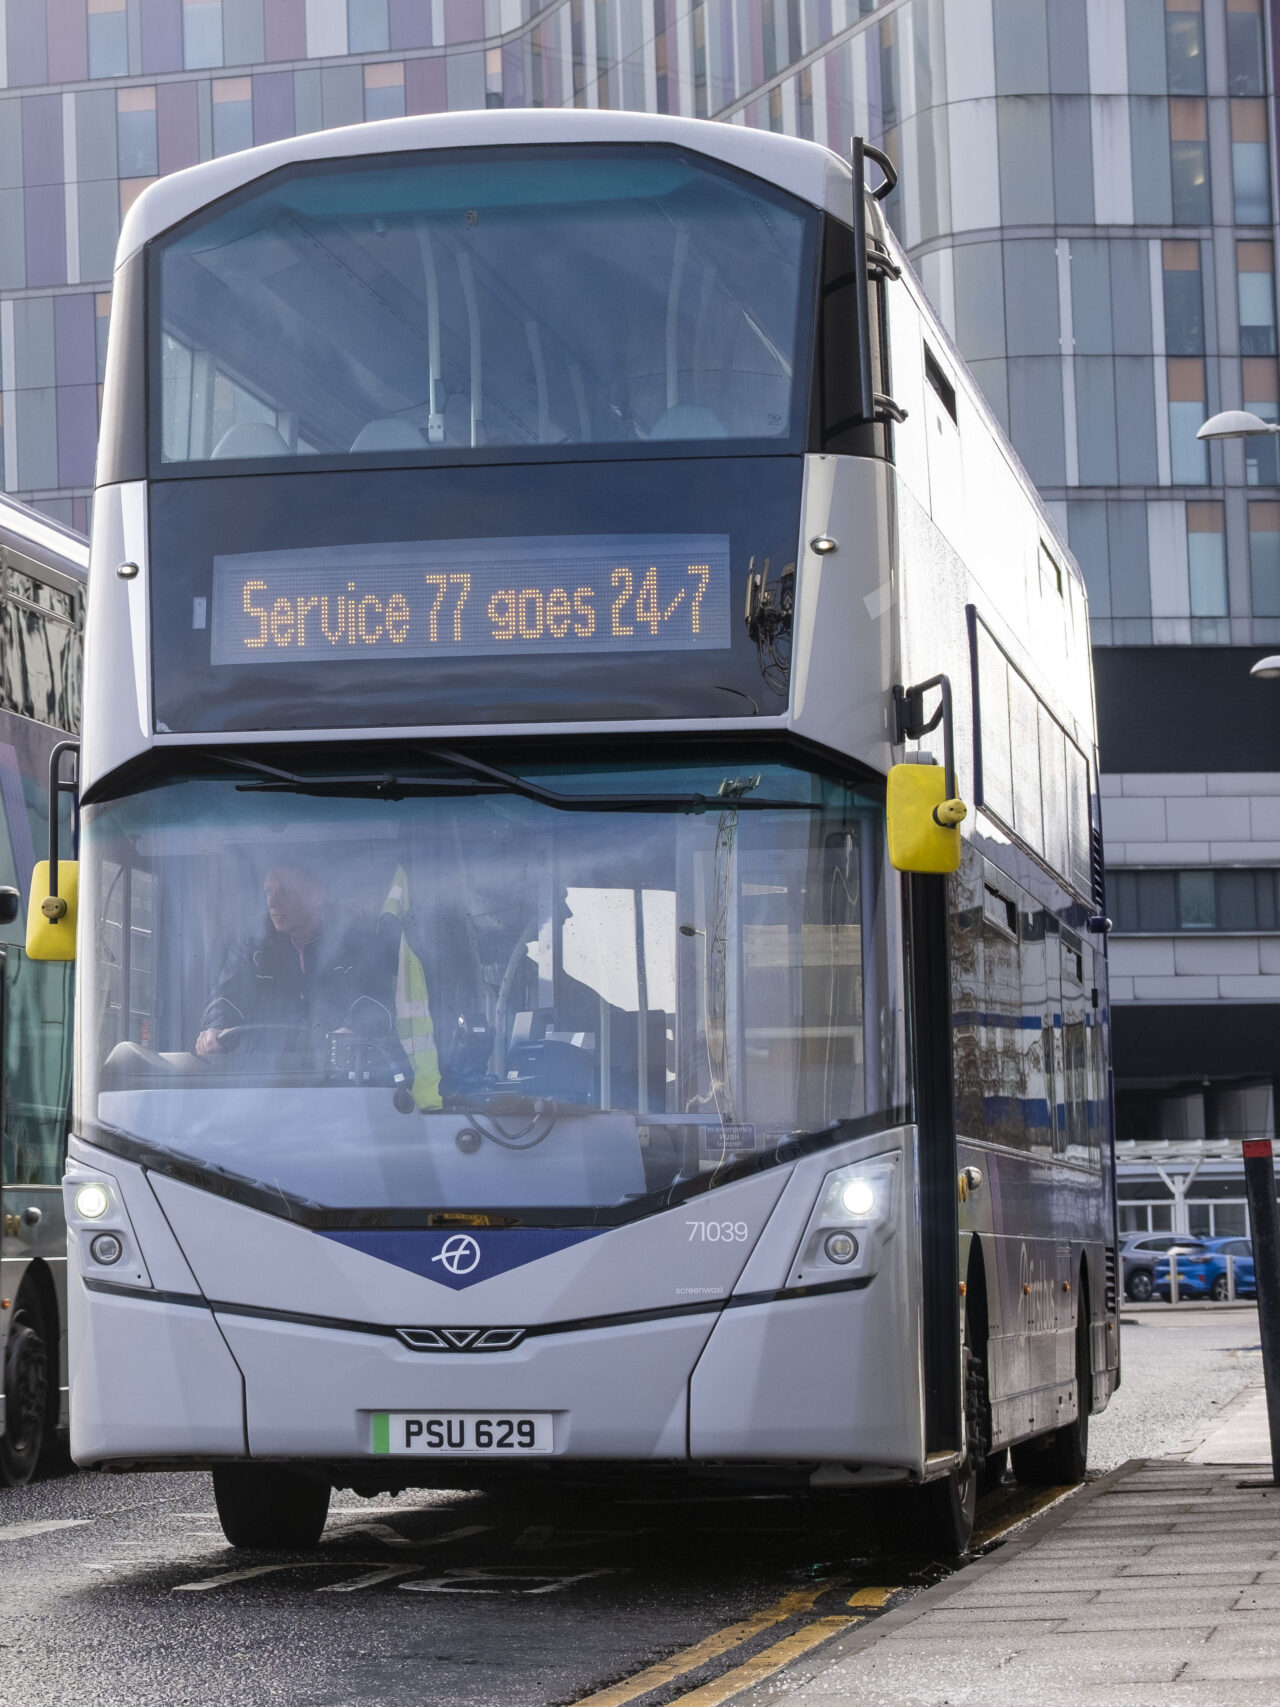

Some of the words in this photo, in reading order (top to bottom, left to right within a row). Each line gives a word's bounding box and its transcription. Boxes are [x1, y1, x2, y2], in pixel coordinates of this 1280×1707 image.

[243, 580, 411, 649] Service
[425, 573, 472, 643] 77
[487, 585, 596, 641] goes
[610, 564, 710, 637] 24/7
[685, 1221, 749, 1242] 71039
[404, 1419, 466, 1449] PSU
[474, 1419, 536, 1449] 629
